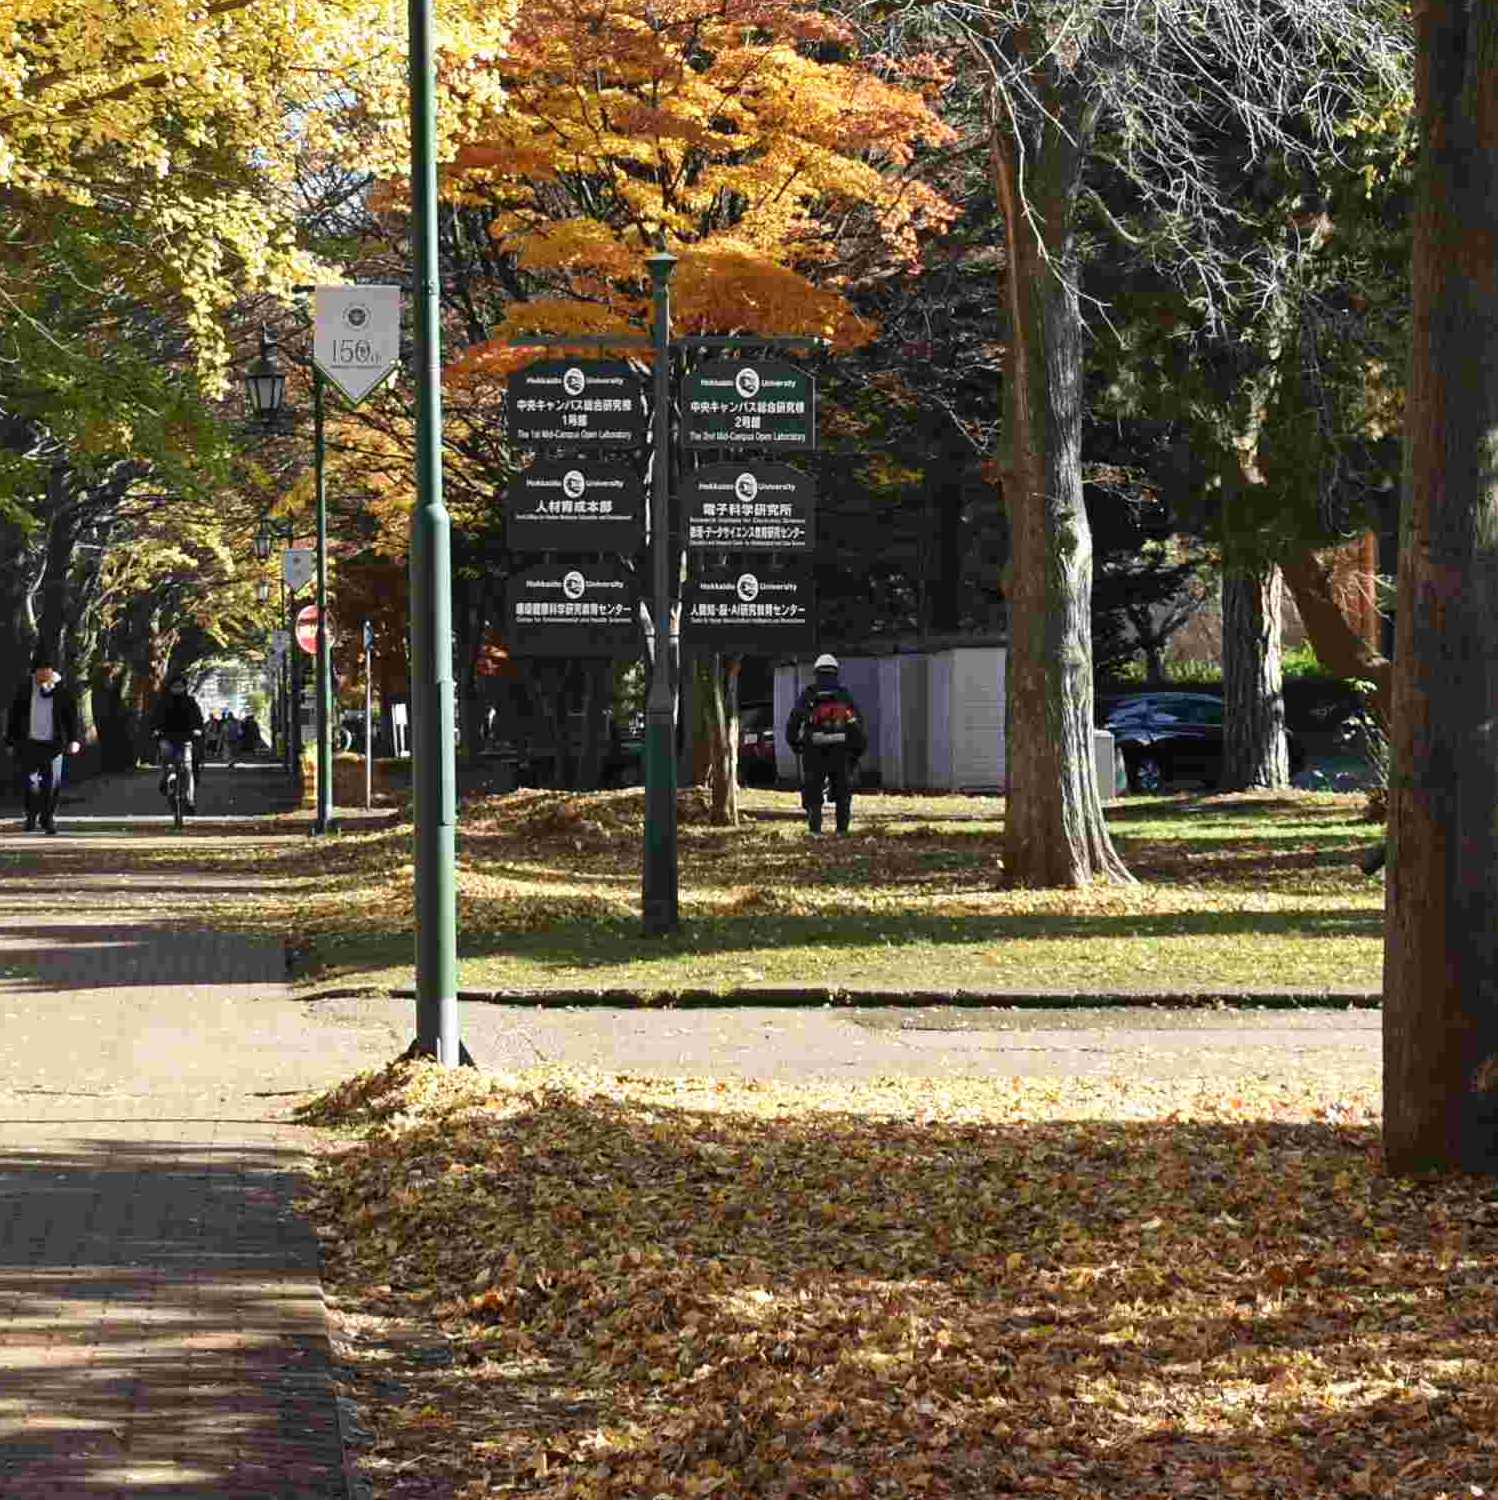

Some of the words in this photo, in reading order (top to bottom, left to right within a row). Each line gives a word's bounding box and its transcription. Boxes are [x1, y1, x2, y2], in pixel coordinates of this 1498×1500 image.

[703, 503, 792, 516] 電子科学研究所
